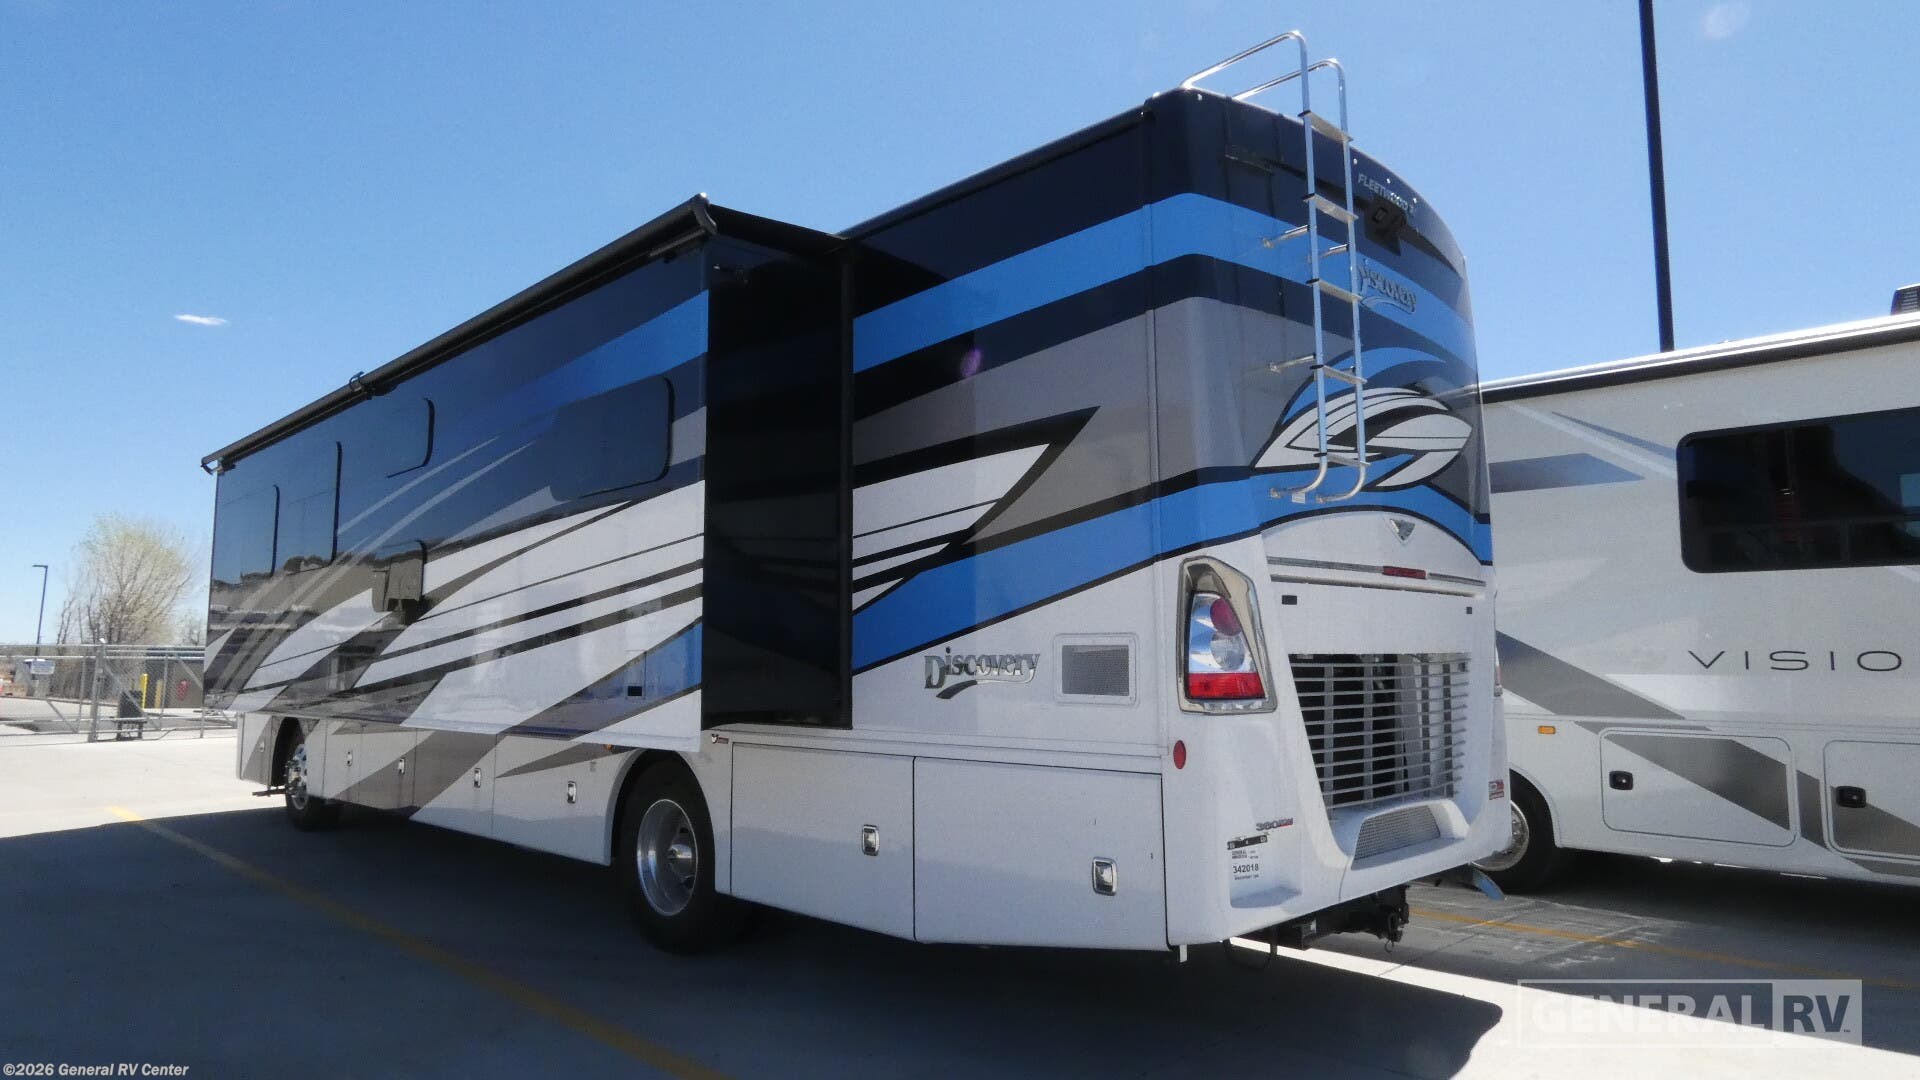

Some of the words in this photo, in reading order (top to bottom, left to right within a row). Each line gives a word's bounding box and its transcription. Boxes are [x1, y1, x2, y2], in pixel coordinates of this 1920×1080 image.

[924, 646, 1041, 689] Discovery
[1688, 650, 1902, 672] VISIO
[1232, 863, 1259, 874] 342018
